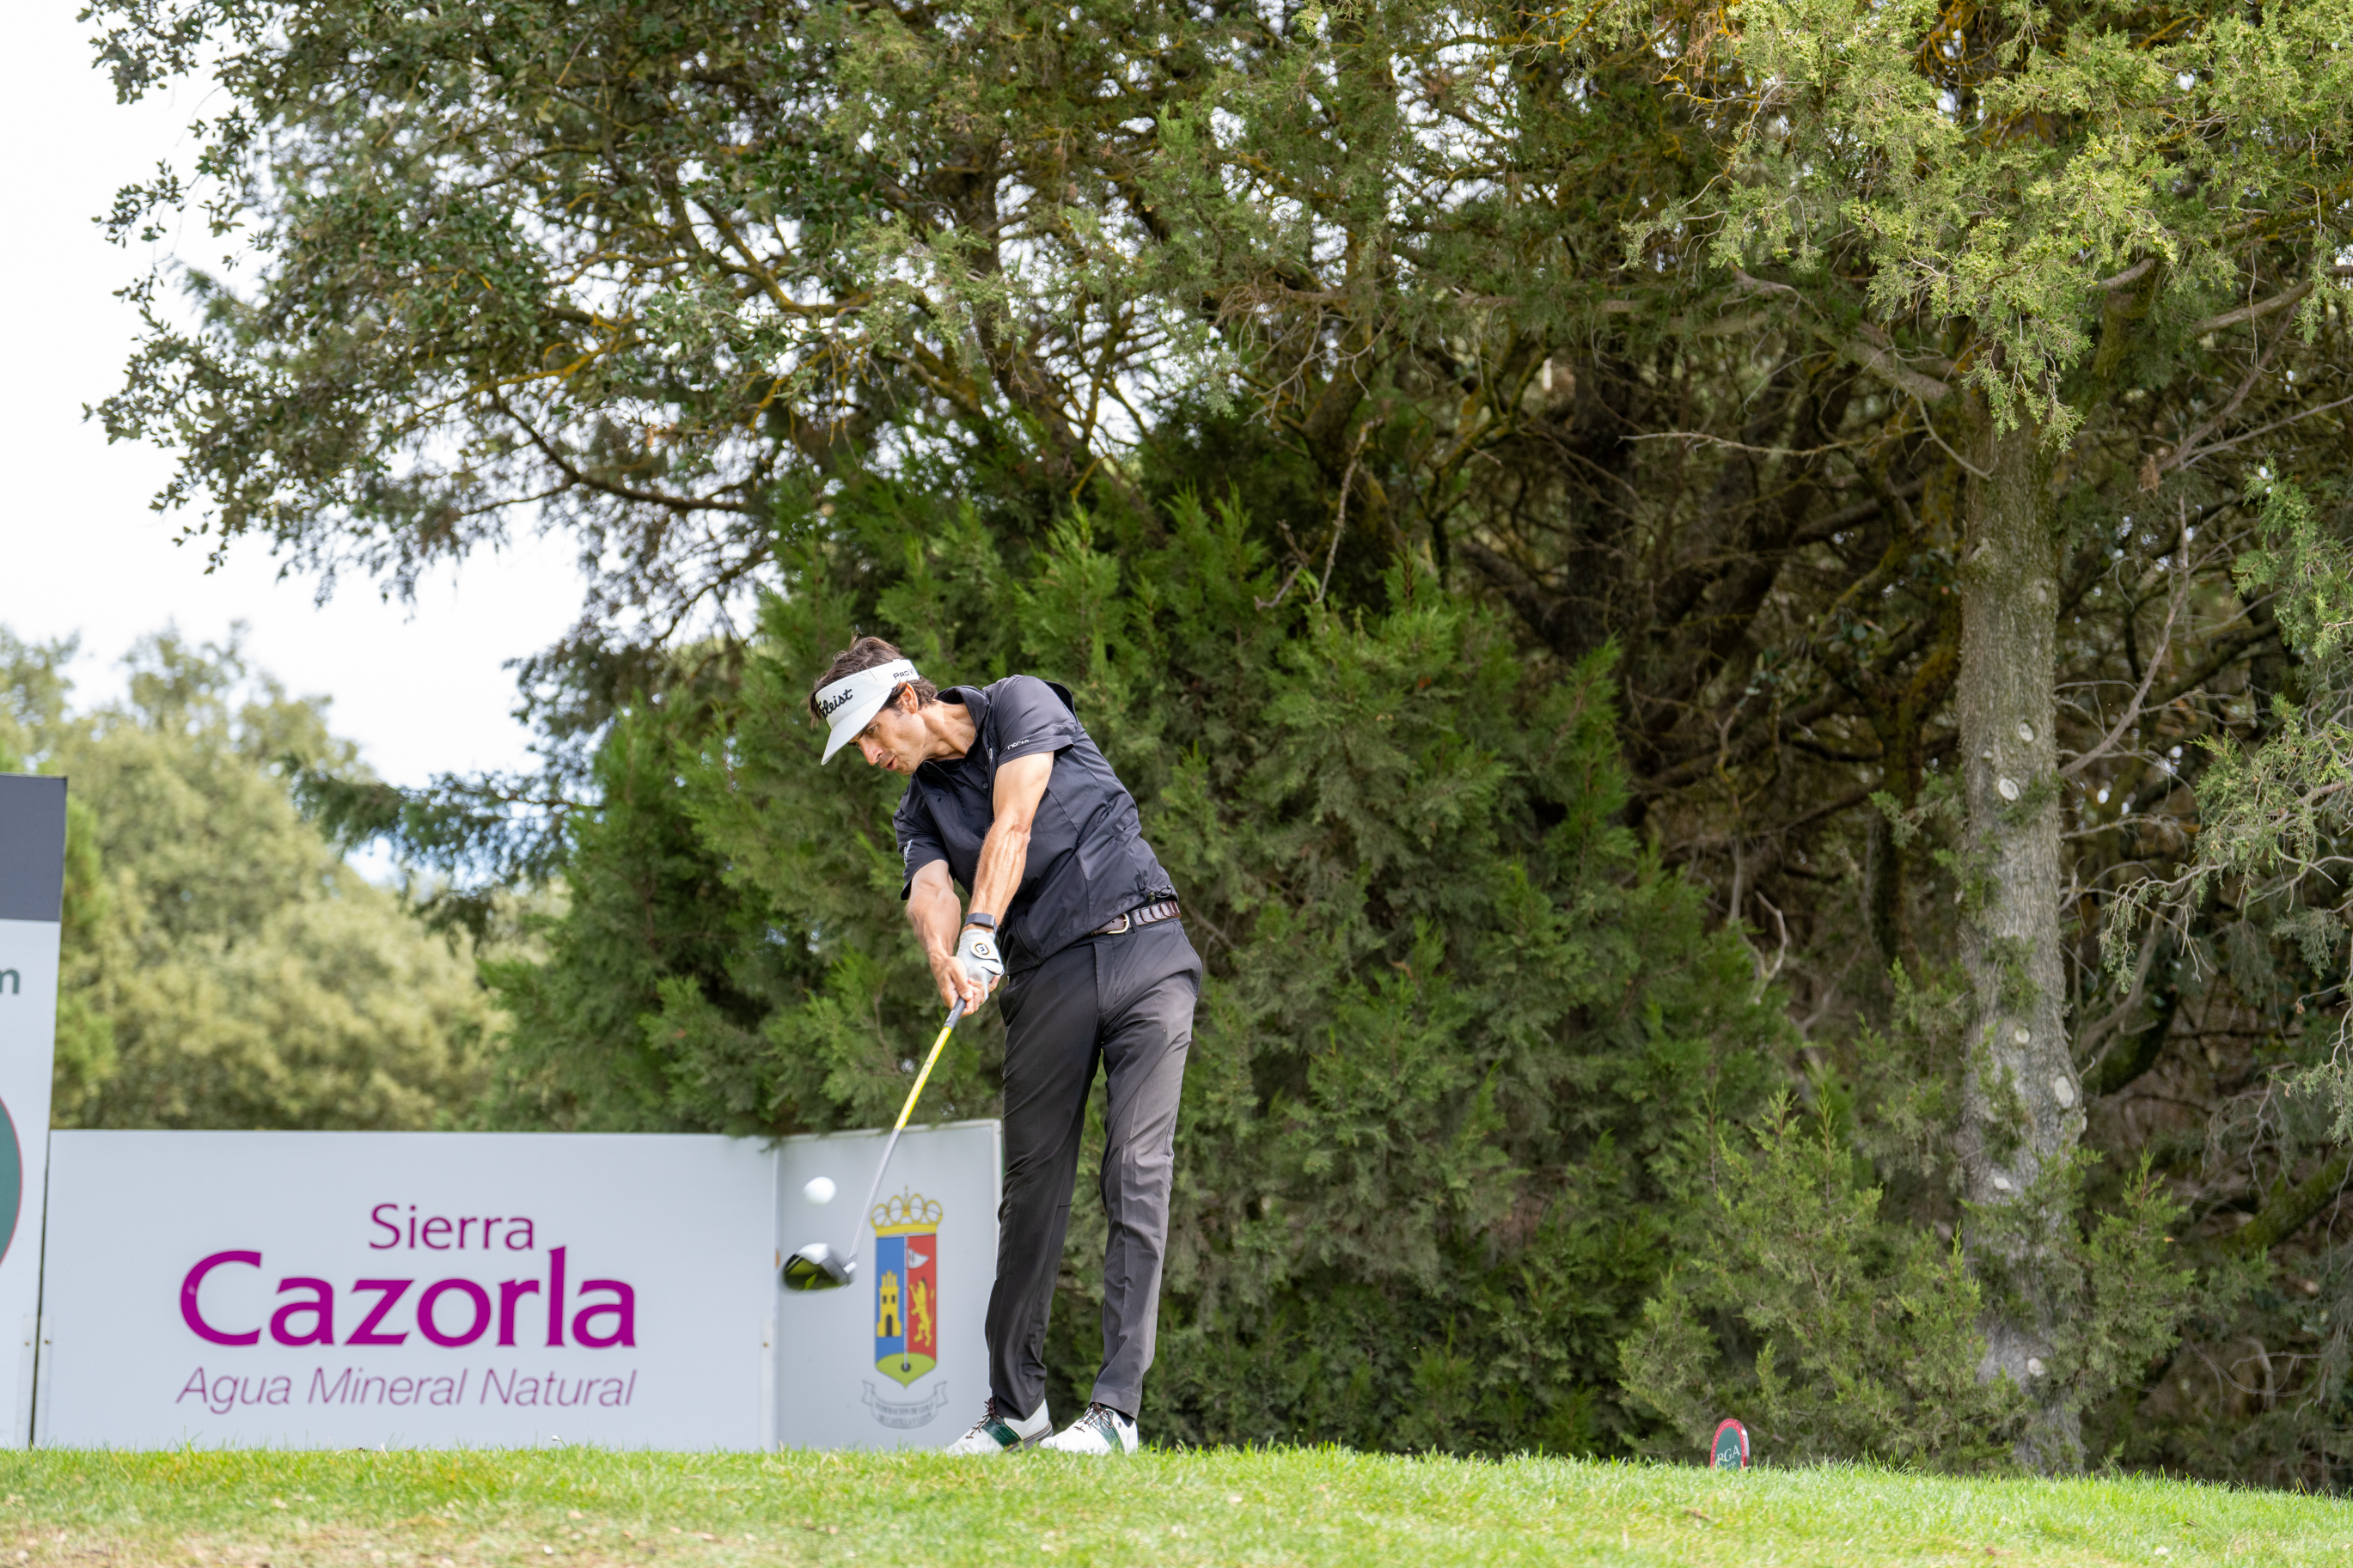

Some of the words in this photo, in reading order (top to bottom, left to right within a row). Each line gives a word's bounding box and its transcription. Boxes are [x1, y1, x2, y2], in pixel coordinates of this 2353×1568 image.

[370, 1203, 535, 1252] Sierra
[179, 1245, 637, 1348] Cazorla
[175, 1366, 291, 1415] Agua
[307, 1366, 469, 1406] Mineral
[478, 1367, 638, 1407] Natural
[1717, 1445, 1740, 1466] PGA
